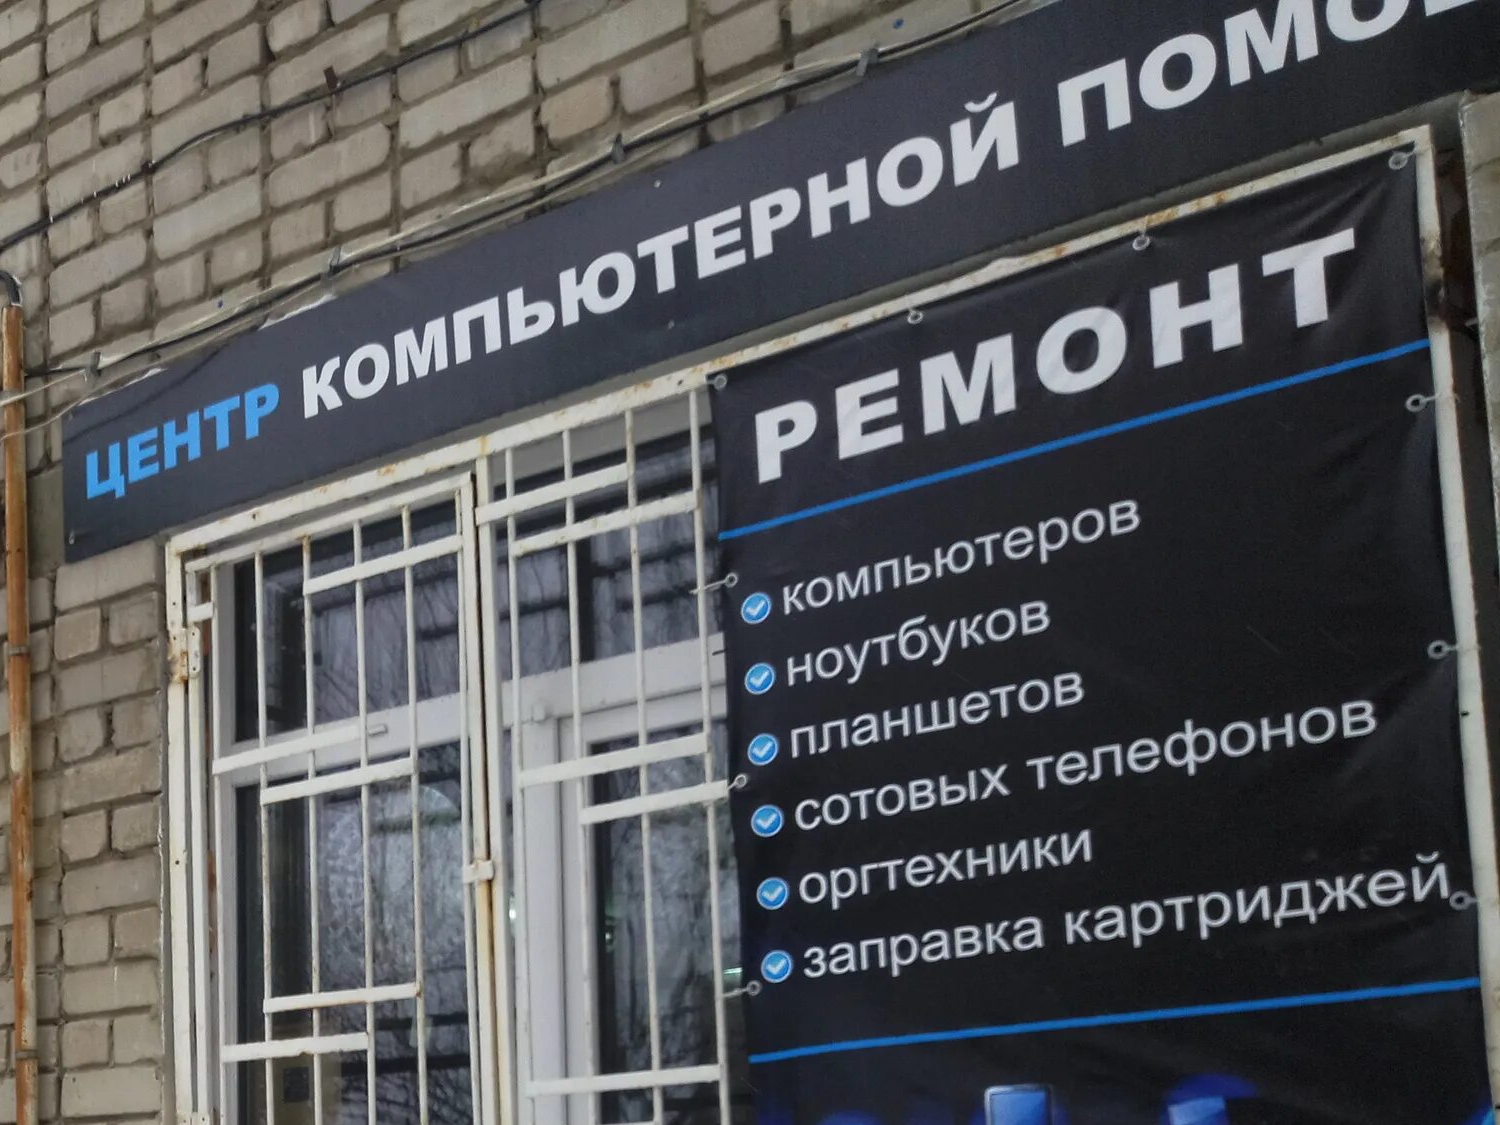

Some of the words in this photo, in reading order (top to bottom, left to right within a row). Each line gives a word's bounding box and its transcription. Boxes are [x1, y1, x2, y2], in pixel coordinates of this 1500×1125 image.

[85, 382, 280, 501] ЦЕНТР
[301, 93, 1020, 420] КОМПЬЮТЕРНОЙ
[1058, 0, 1478, 146] ПОМО
[755, 228, 1356, 484] РЕМОНТ
[782, 499, 1142, 614] компьютеров
[786, 598, 1050, 686] ноутбуков
[791, 670, 1084, 760] планшетов
[794, 763, 1010, 832] сотовых
[1028, 698, 1378, 794] телефонов
[799, 827, 1093, 910] оргтехники
[803, 915, 1044, 978] заправка
[1065, 852, 1450, 945] картриджей
